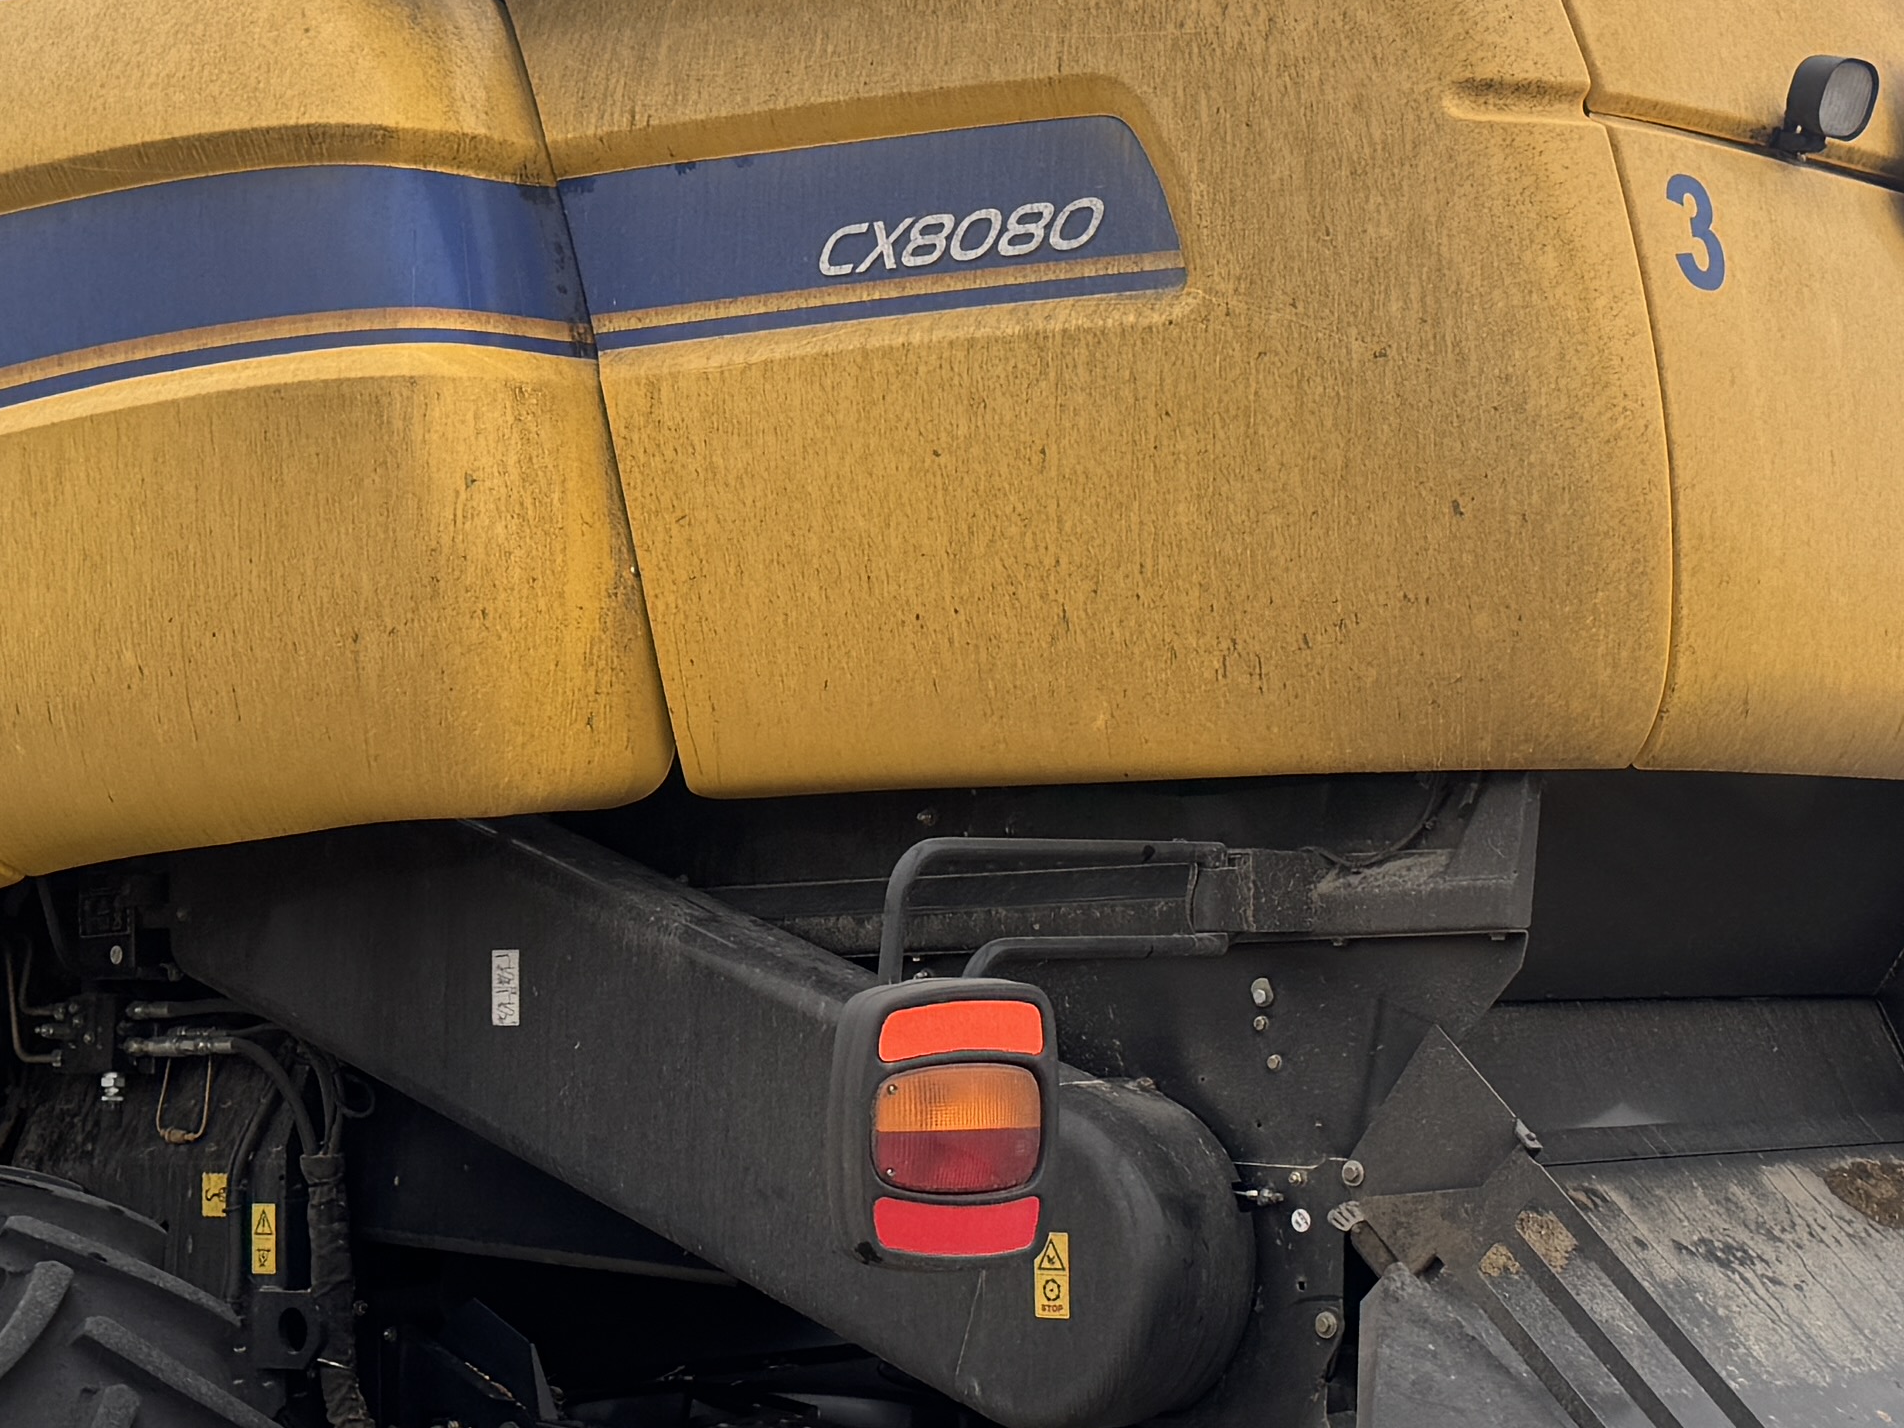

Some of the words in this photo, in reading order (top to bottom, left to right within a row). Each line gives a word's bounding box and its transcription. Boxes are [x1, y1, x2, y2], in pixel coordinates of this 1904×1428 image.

[819, 197, 1104, 276] CX8080
[1666, 173, 1725, 291] 3
[1041, 1304, 1064, 1313] STOP
